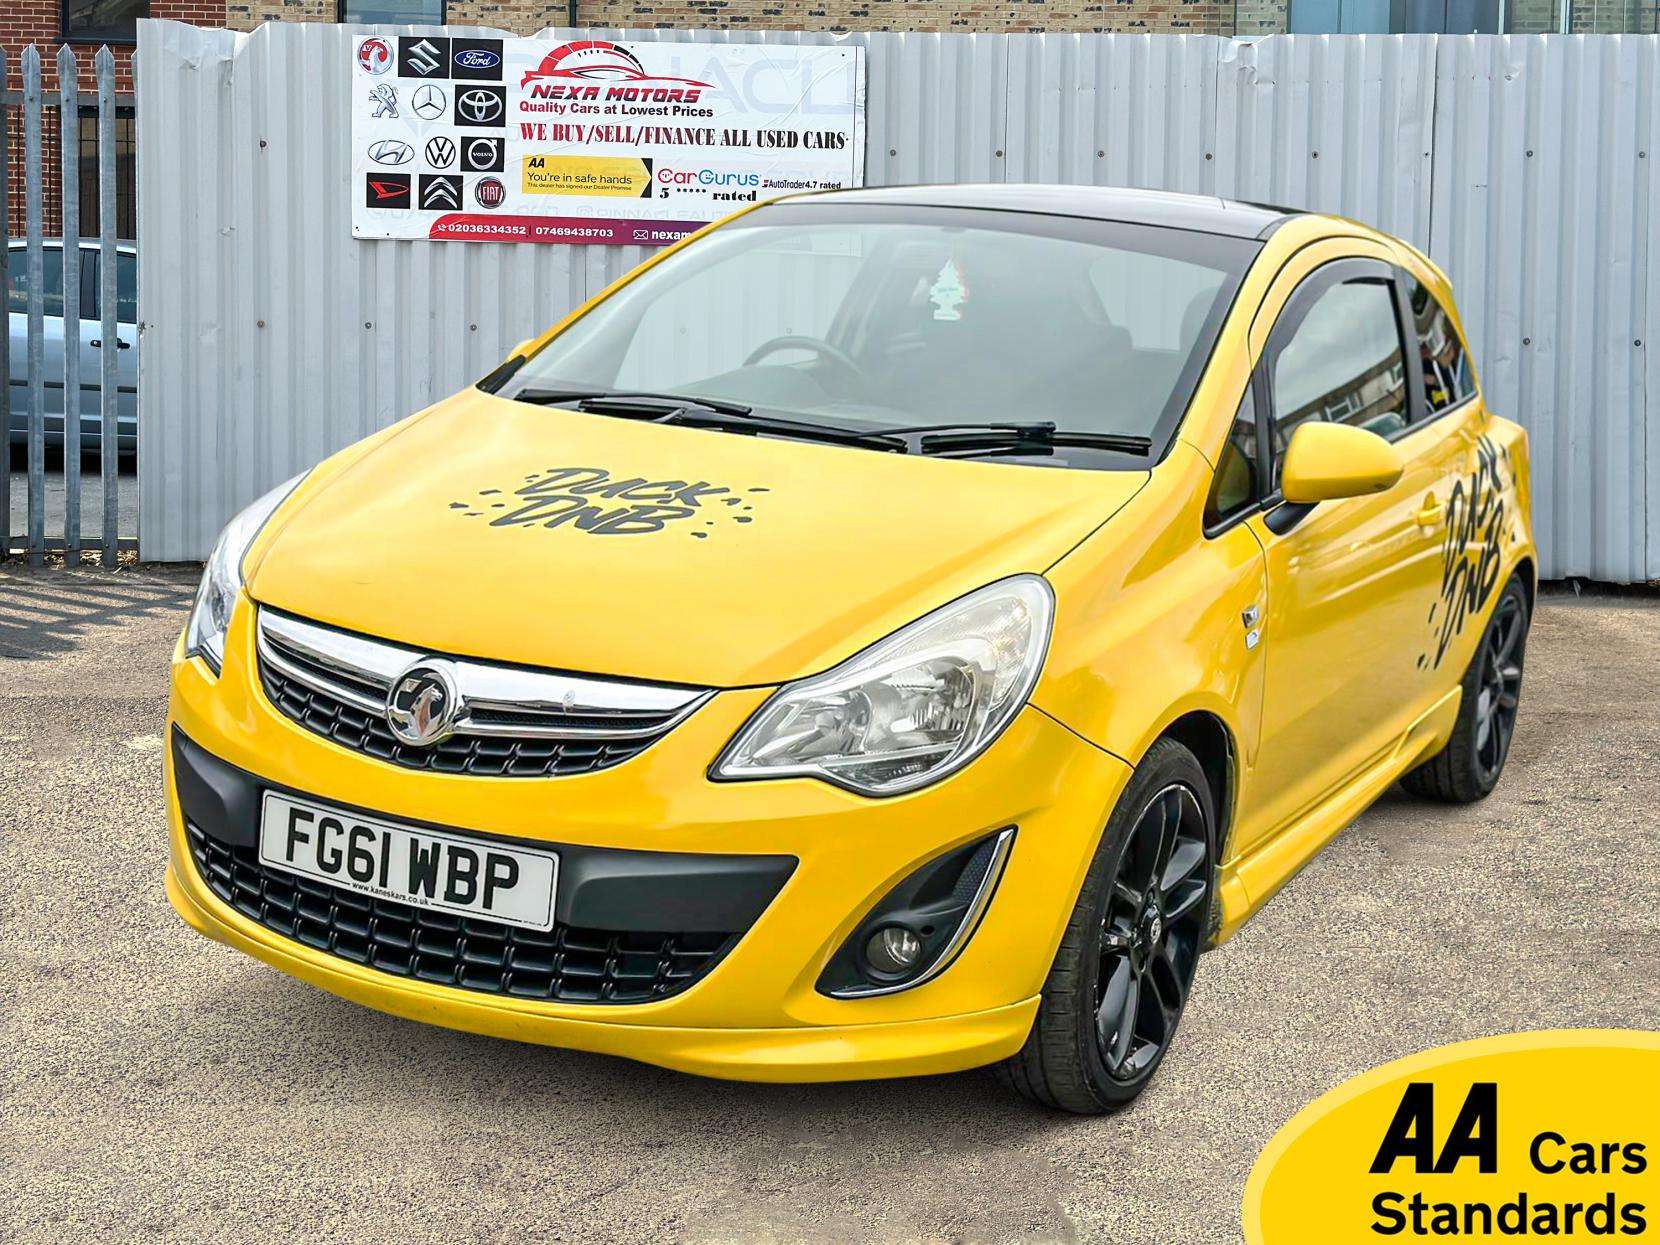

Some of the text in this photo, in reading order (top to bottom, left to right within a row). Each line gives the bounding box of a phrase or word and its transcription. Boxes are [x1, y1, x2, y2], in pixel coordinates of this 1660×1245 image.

[463, 52, 491, 66] Ford
[531, 85, 702, 104] NEXA MOTORS
[519, 101, 714, 118] Quality Cars at Lowest Prices
[519, 123, 845, 150] WE BUY/SELL/FINANCE ALL USED CARS
[528, 157, 545, 168] AA
[527, 172, 632, 185] You're in safe hands
[657, 168, 759, 187] CarGurus
[482, 185, 500, 201] FIAT
[819, 181, 842, 190] rated
[659, 187, 757, 202] 5 rated
[448, 224, 614, 238] 02036334352 07469438703
[285, 806, 520, 910] FG61 WBP
